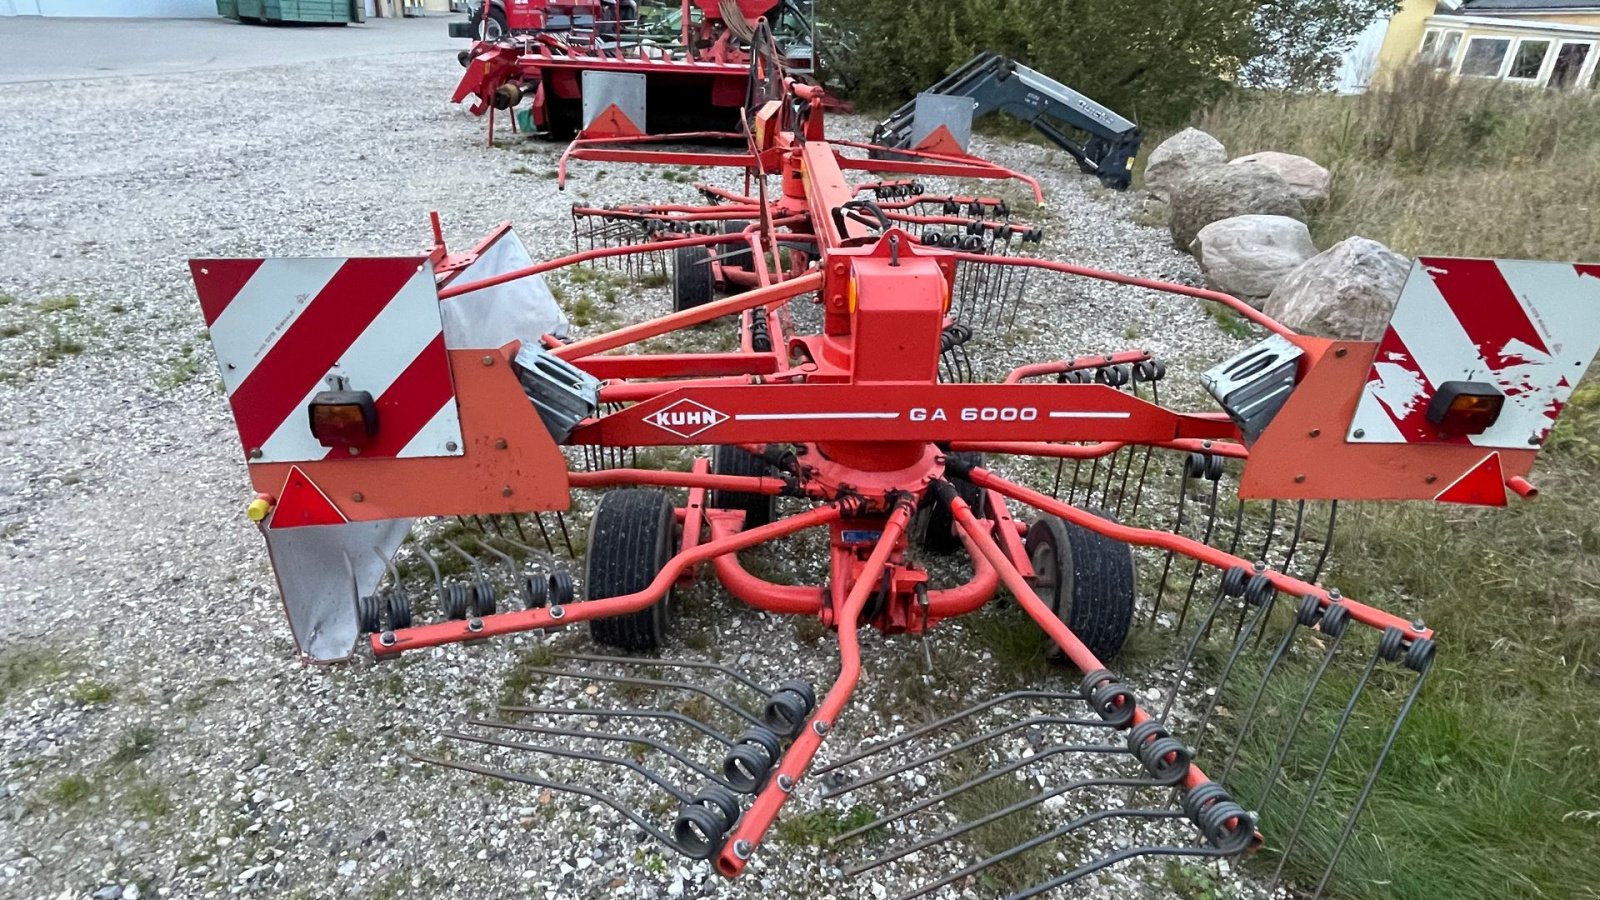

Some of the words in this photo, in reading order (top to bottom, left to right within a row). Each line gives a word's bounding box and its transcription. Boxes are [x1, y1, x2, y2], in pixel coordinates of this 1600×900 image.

[656, 411, 717, 426] KUHN
[909, 407, 948, 421] GA
[960, 407, 1038, 421] 6000
